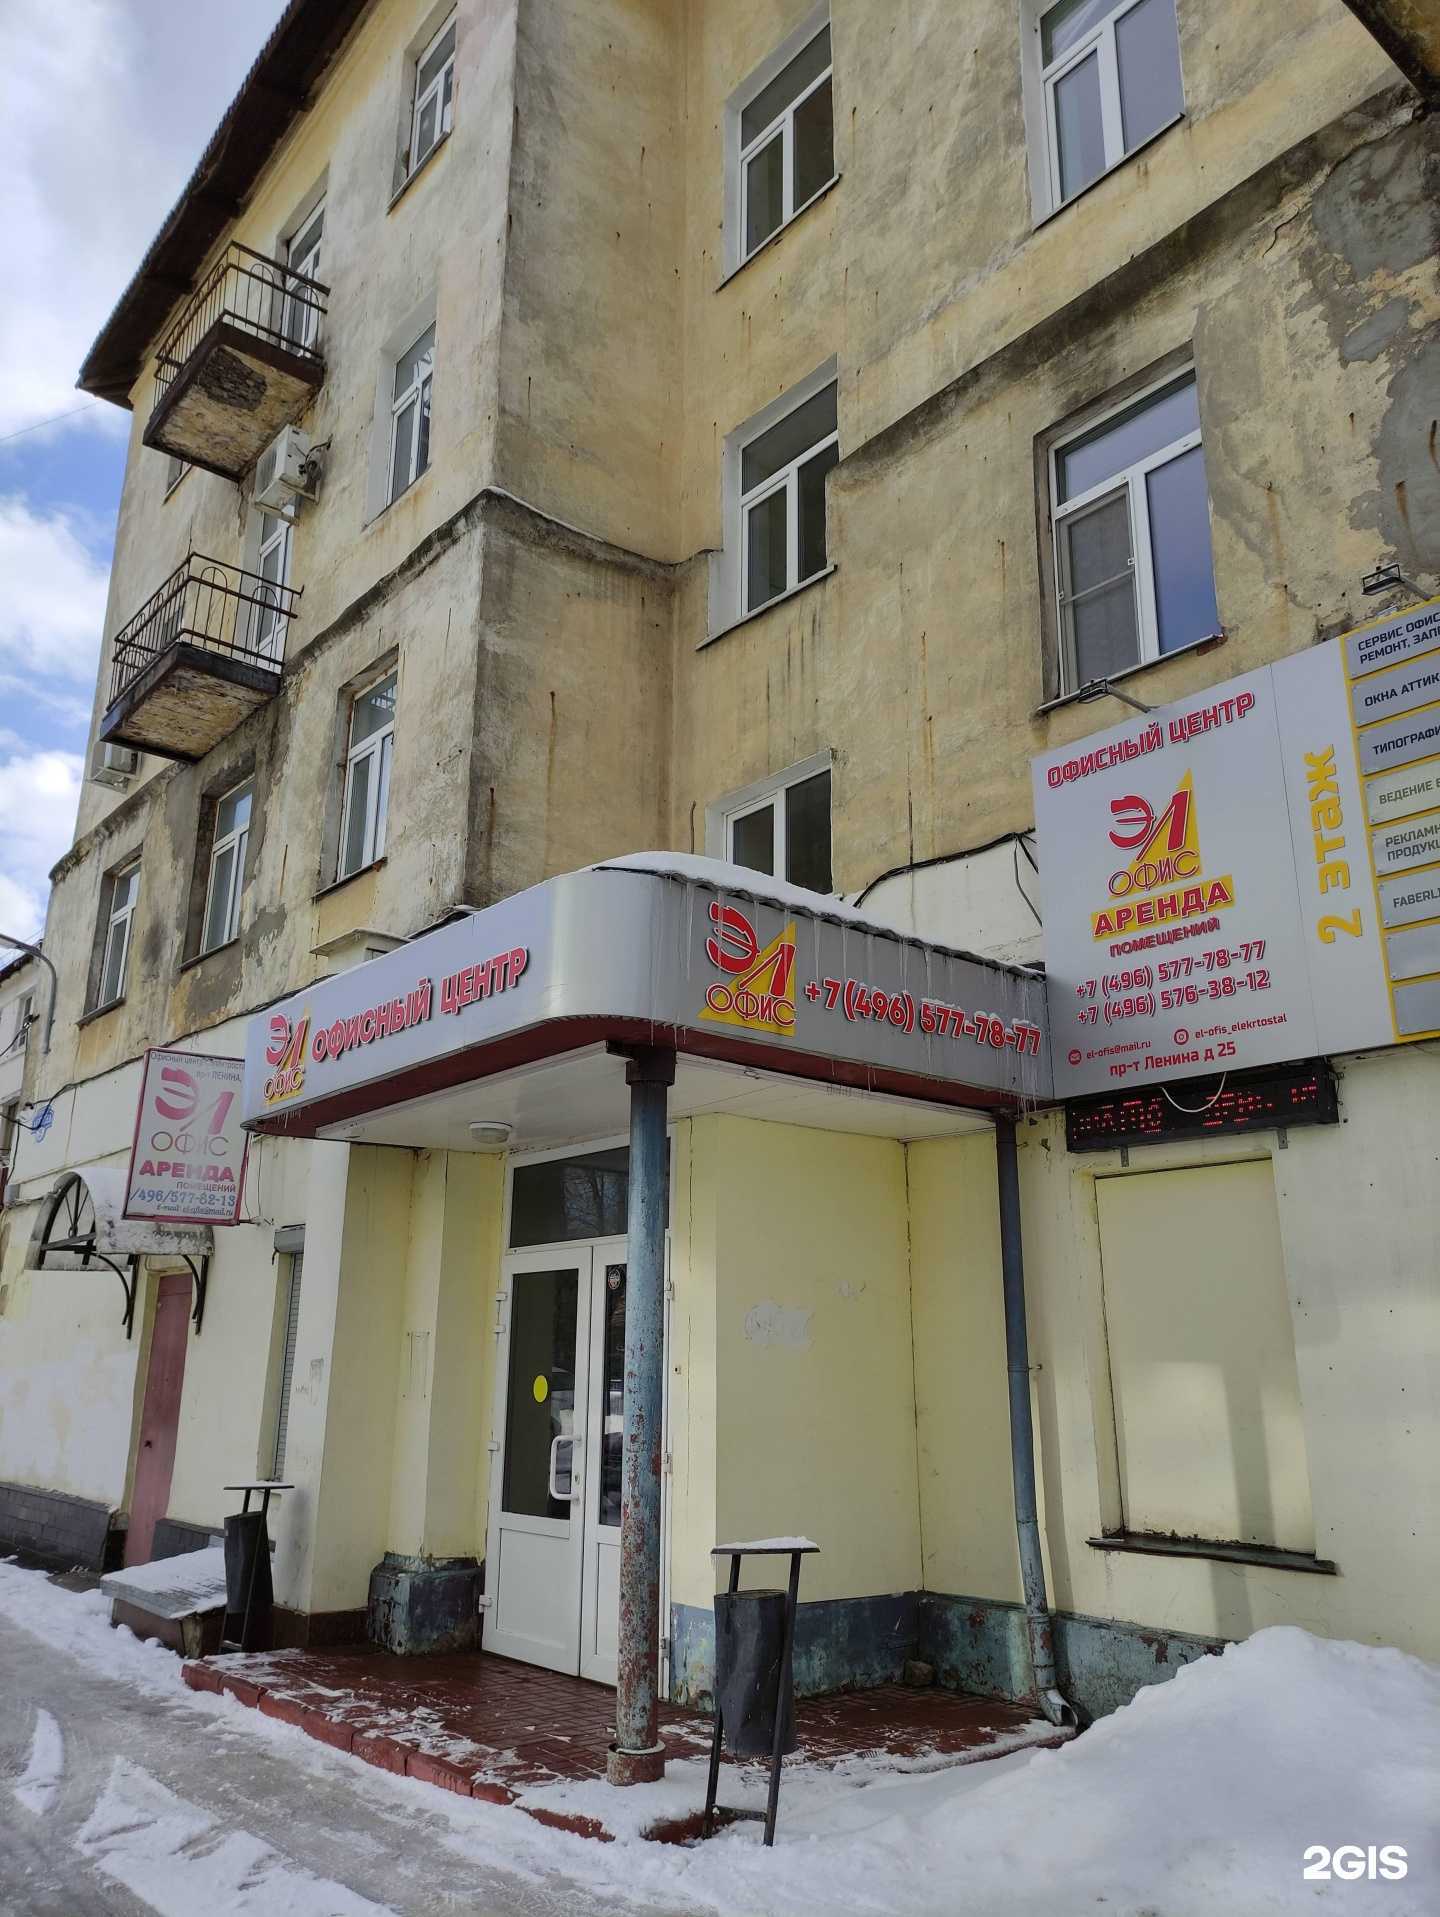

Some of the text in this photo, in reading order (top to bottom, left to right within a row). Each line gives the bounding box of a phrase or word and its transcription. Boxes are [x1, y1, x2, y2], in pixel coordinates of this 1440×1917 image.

[1358, 626, 1404, 651] СЕРВИС
[1364, 672, 1440, 707] ОКНА АТТИК
[1047, 691, 1255, 789] ОФИСНЫЙ ЦЕНТР
[1379, 780, 1433, 805] ВЕДЕНИЕ
[1108, 788, 1191, 863] ЭЛ
[1108, 850, 1201, 896] ОФИС
[1094, 880, 1232, 937] АРЕНДА
[1317, 908, 1363, 944] 2
[705, 901, 797, 998] ЭЛ
[1109, 916, 1221, 958] ПОМЕЩЕНИЙ
[1076, 940, 1266, 998] +7 (496) 577-78-77
[311, 946, 528, 1061] ОФИСНЫЙ ЦЕНТР
[706, 982, 796, 1027] ОФИС
[804, 977, 1042, 1056] +7 (496) 577-78-77
[1078, 969, 1270, 1025] +7 (496) 576-38-12
[1086, 1040, 1152, 1059] el-ofis@mail.ru
[1109, 1041, 1237, 1077] пр-т Ленина д 25
[264, 1066, 305, 1100] ОФИС
[139, 1160, 234, 1182] АРЕНДА
